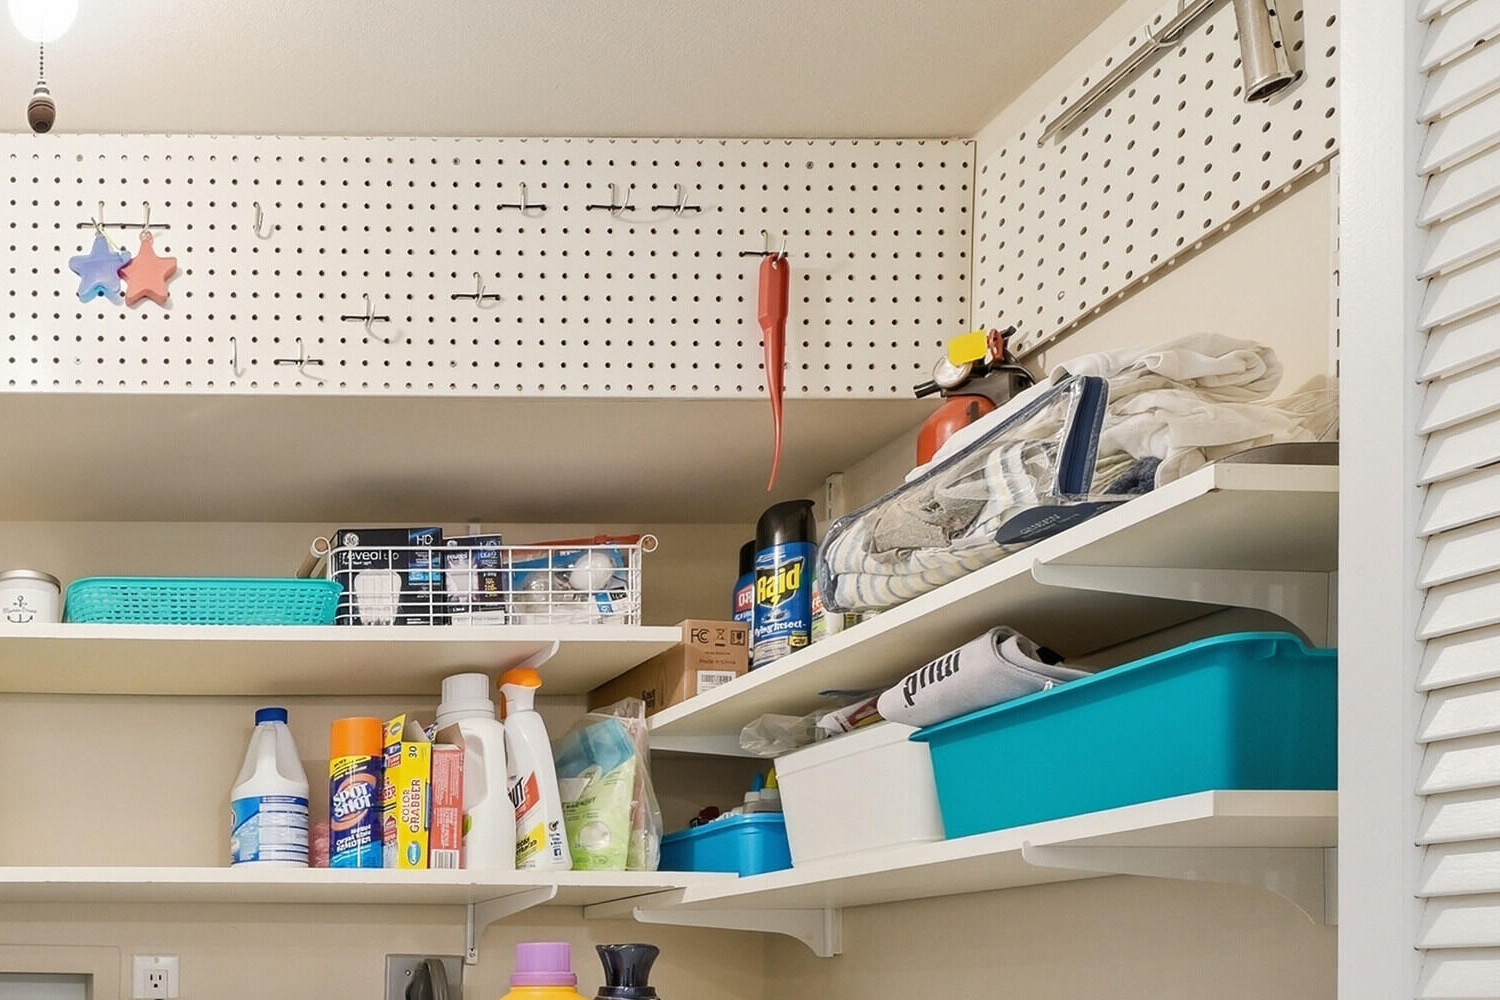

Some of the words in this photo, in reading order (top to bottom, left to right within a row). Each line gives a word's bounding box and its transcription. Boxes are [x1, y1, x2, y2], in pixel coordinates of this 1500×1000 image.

[757, 562, 802, 605] Raid
[408, 745, 418, 759] 30
[333, 782, 370, 807] SPOT
[334, 793, 373, 818] SHOT
[401, 789, 411, 823] COLOR
[409, 779, 422, 834] GRABBER
